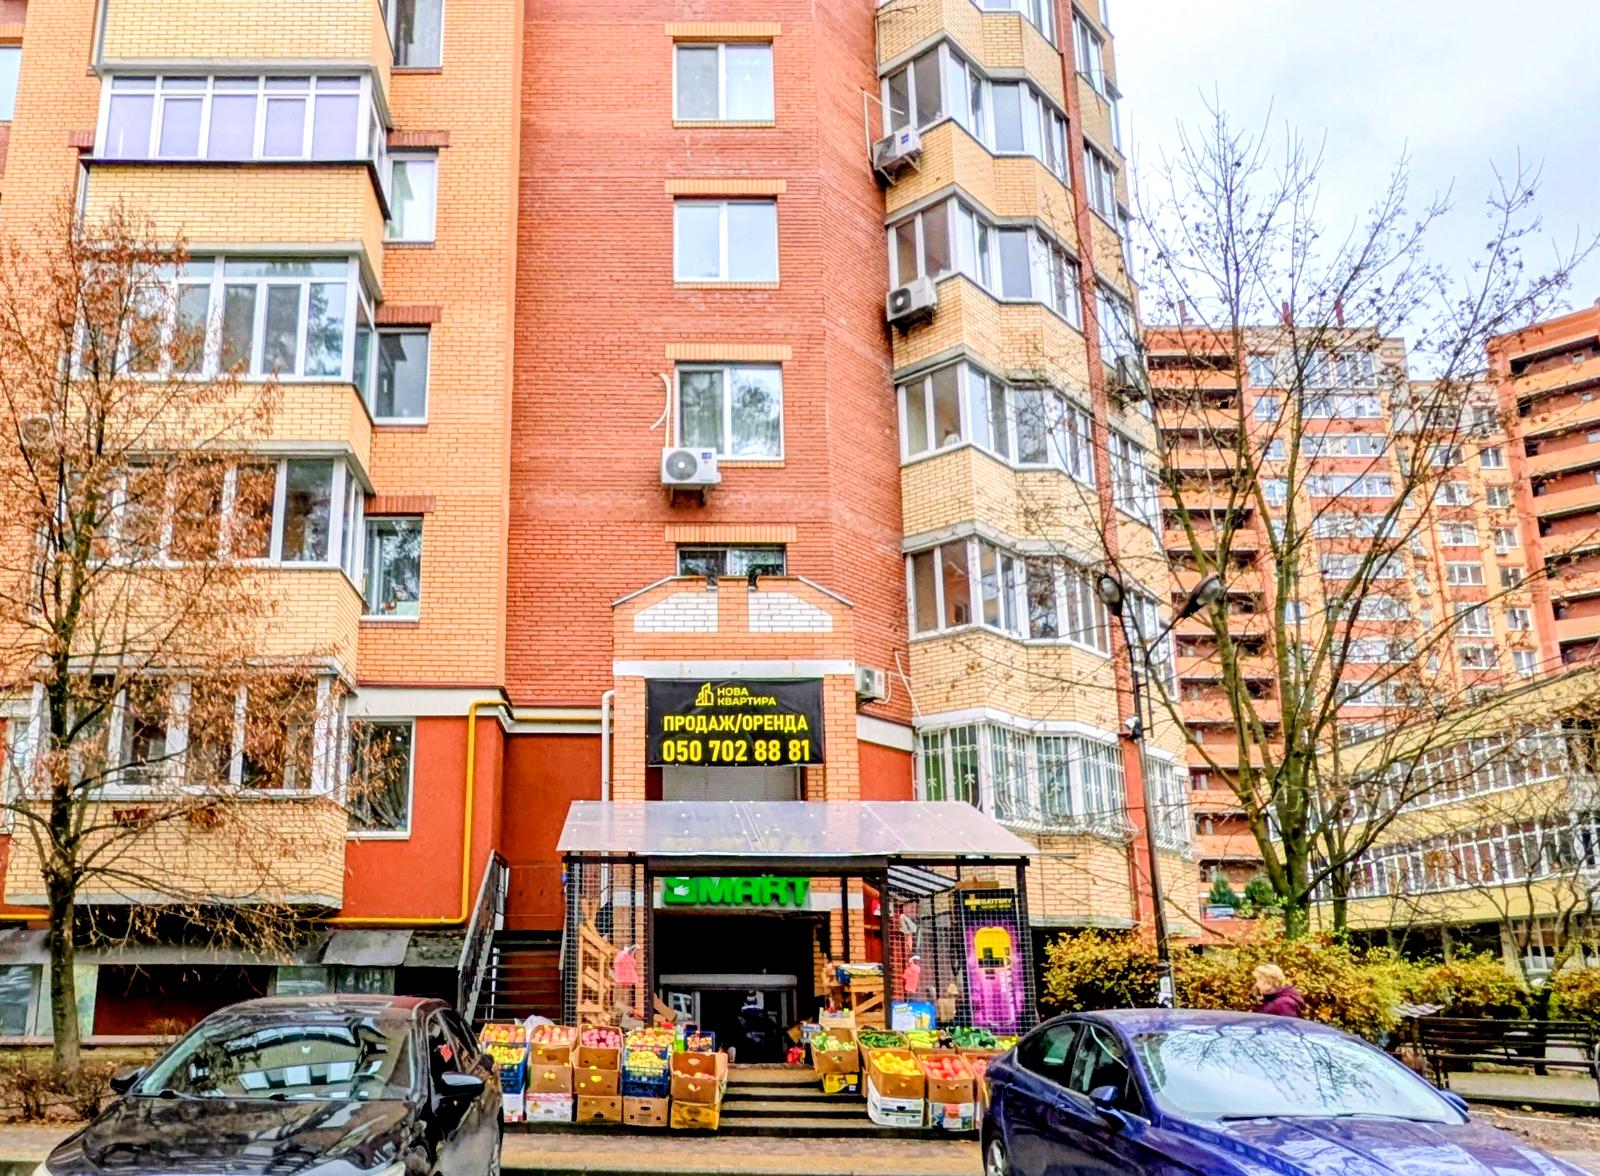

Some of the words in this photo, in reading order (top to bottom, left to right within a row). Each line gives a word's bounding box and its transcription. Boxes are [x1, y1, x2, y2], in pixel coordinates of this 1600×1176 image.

[717, 687, 749, 697] НОВА
[717, 696, 777, 706] КВАРТИРА
[663, 714, 809, 733] ПРОДАЖ/ОРЕНДА
[662, 739, 702, 762] 050
[708, 739, 748, 762] 702
[754, 739, 781, 762] 88
[788, 739, 810, 762] 81
